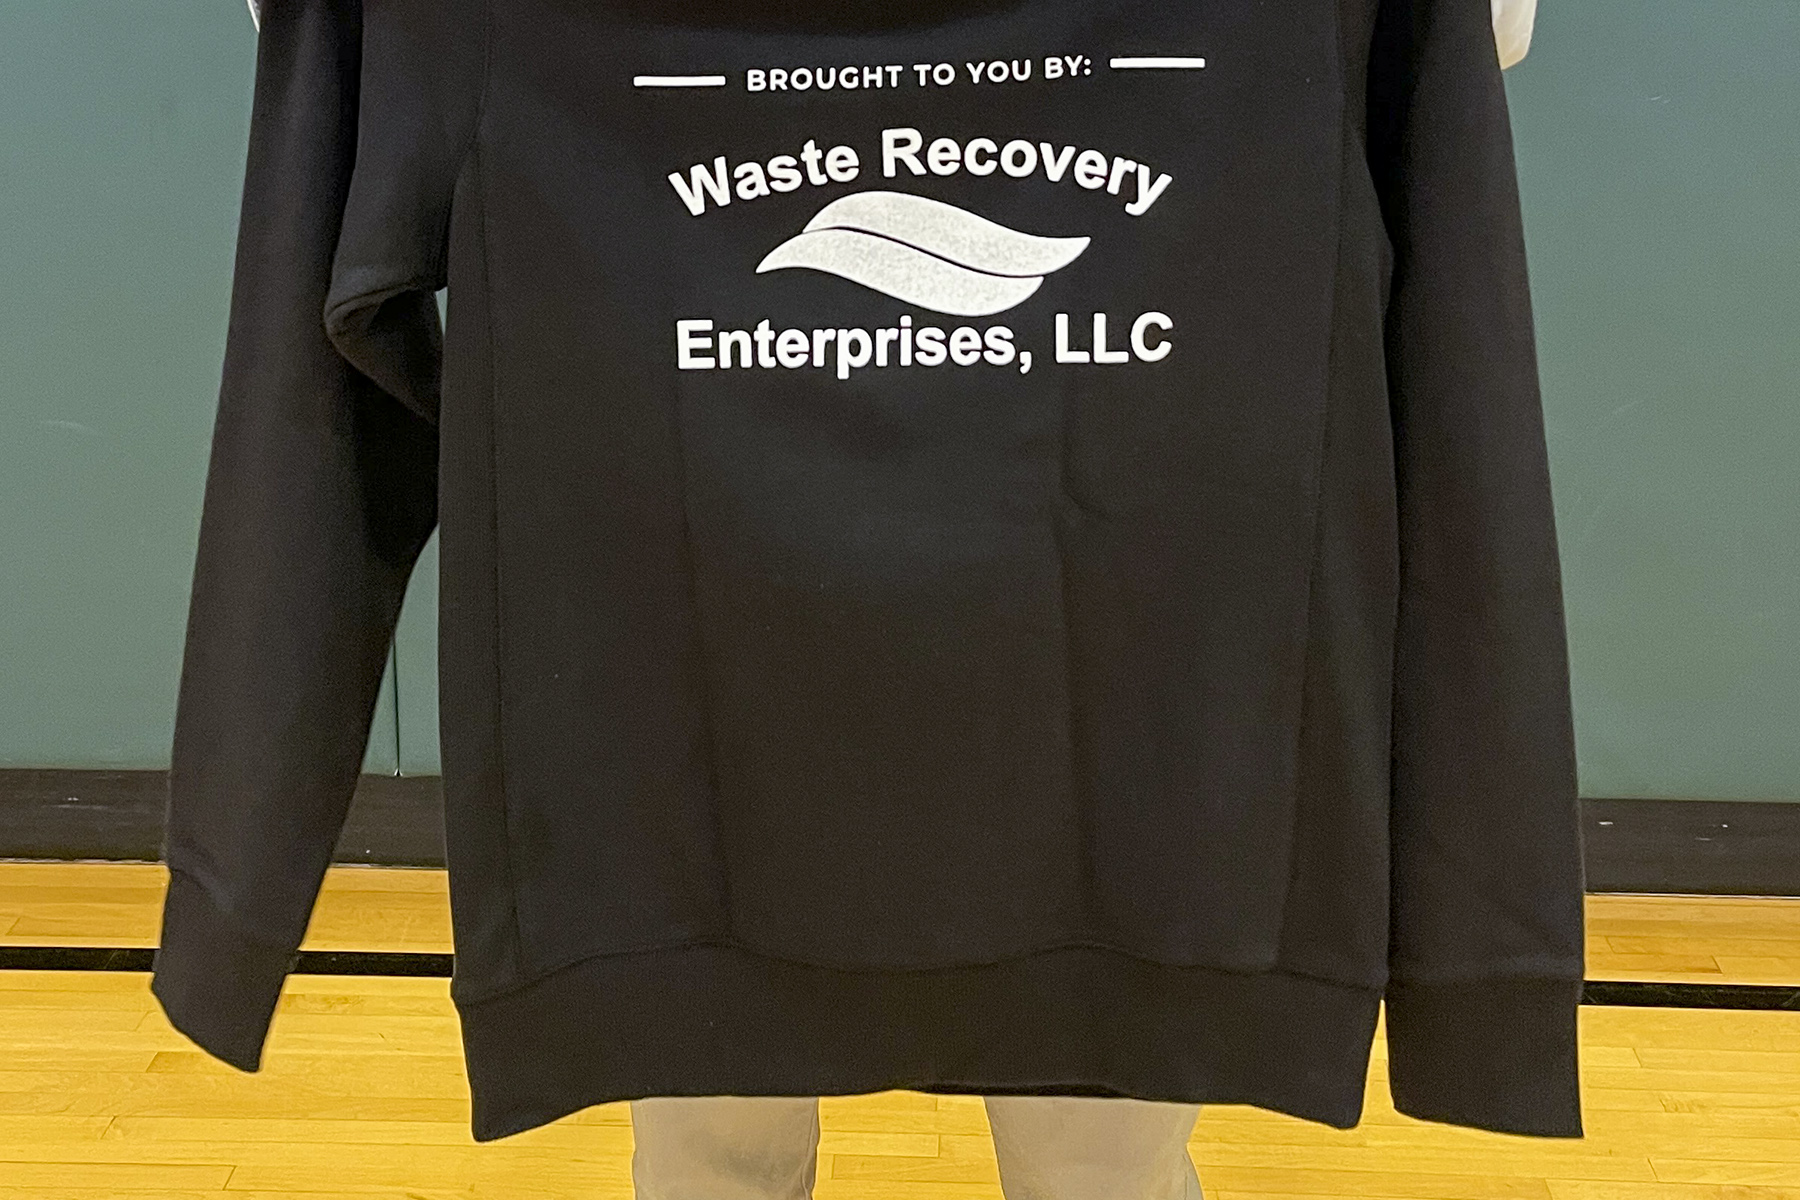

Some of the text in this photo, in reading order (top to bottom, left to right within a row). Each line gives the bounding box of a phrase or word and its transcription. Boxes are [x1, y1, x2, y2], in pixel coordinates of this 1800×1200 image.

[747, 54, 1092, 92] BROUGHT TO YOU BY:
[667, 127, 1173, 217] Waste Recovery
[676, 311, 1174, 380] Enterprises, LLC
